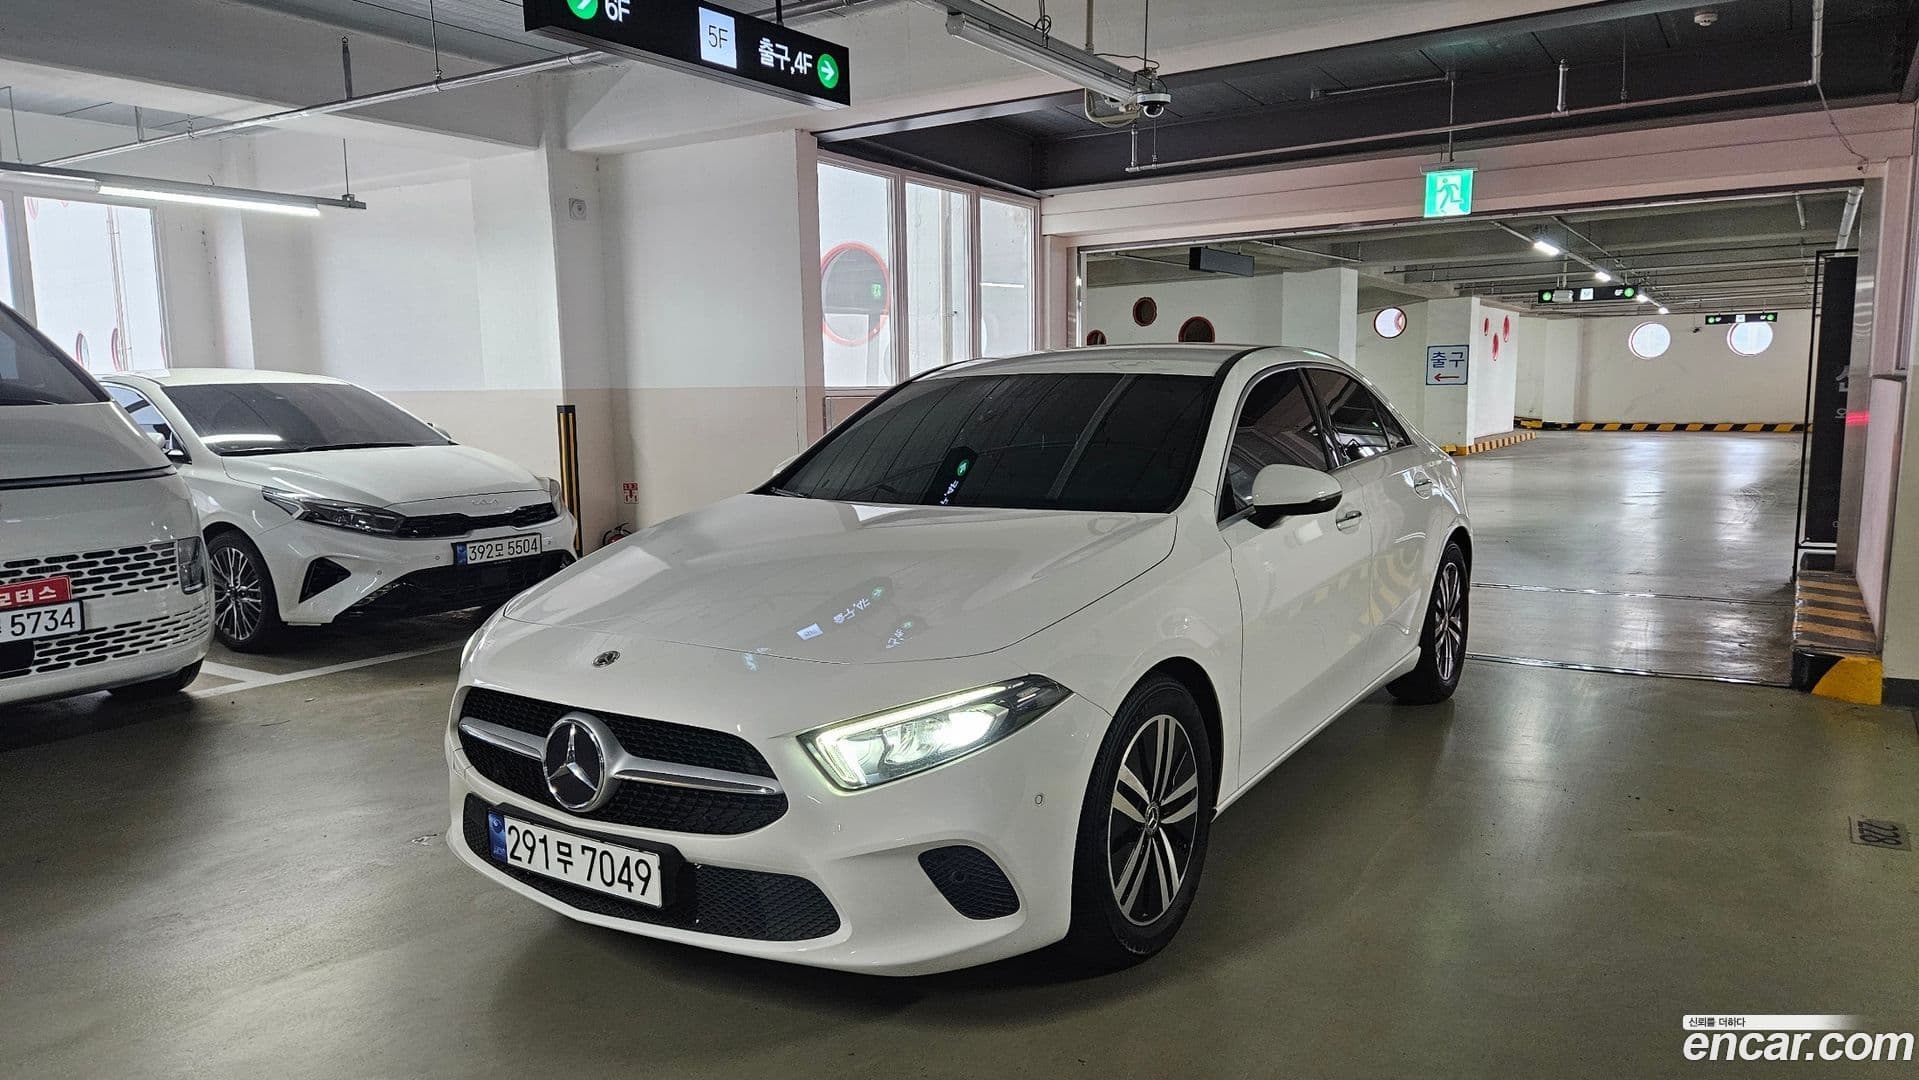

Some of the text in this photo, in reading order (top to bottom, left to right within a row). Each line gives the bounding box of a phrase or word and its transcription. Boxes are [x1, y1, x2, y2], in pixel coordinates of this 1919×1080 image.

[605, 0, 630, 22] 6F
[708, 25, 728, 49] 5F
[1430, 351, 1465, 369] 출구
[508, 538, 538, 556] 5504
[11, 607, 75, 637] 5734
[507, 825, 652, 896] 291무 7049
